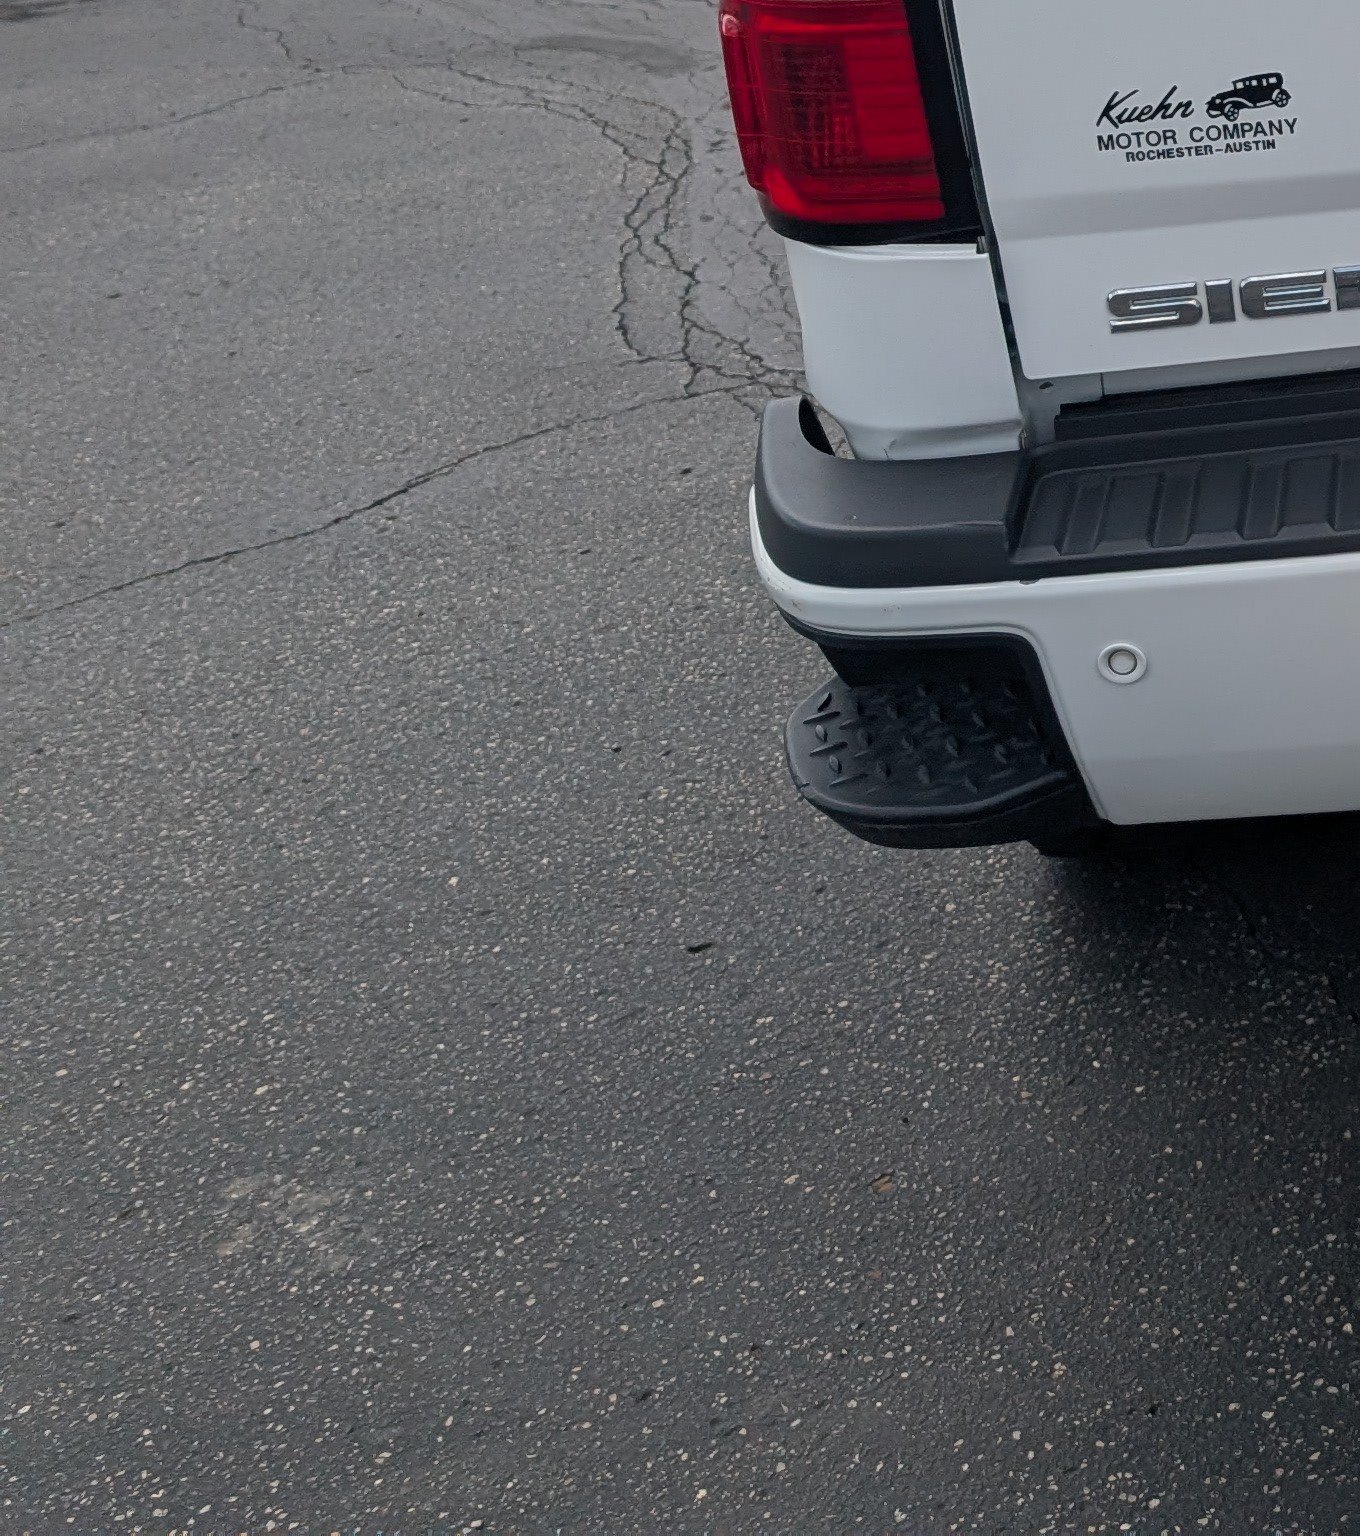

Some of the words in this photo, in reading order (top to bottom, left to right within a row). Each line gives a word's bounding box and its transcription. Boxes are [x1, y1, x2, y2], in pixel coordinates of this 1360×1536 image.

[1096, 84, 1195, 129] Kuehn
[1096, 128, 1178, 152] MOTOR
[1189, 117, 1298, 144] COMPANY
